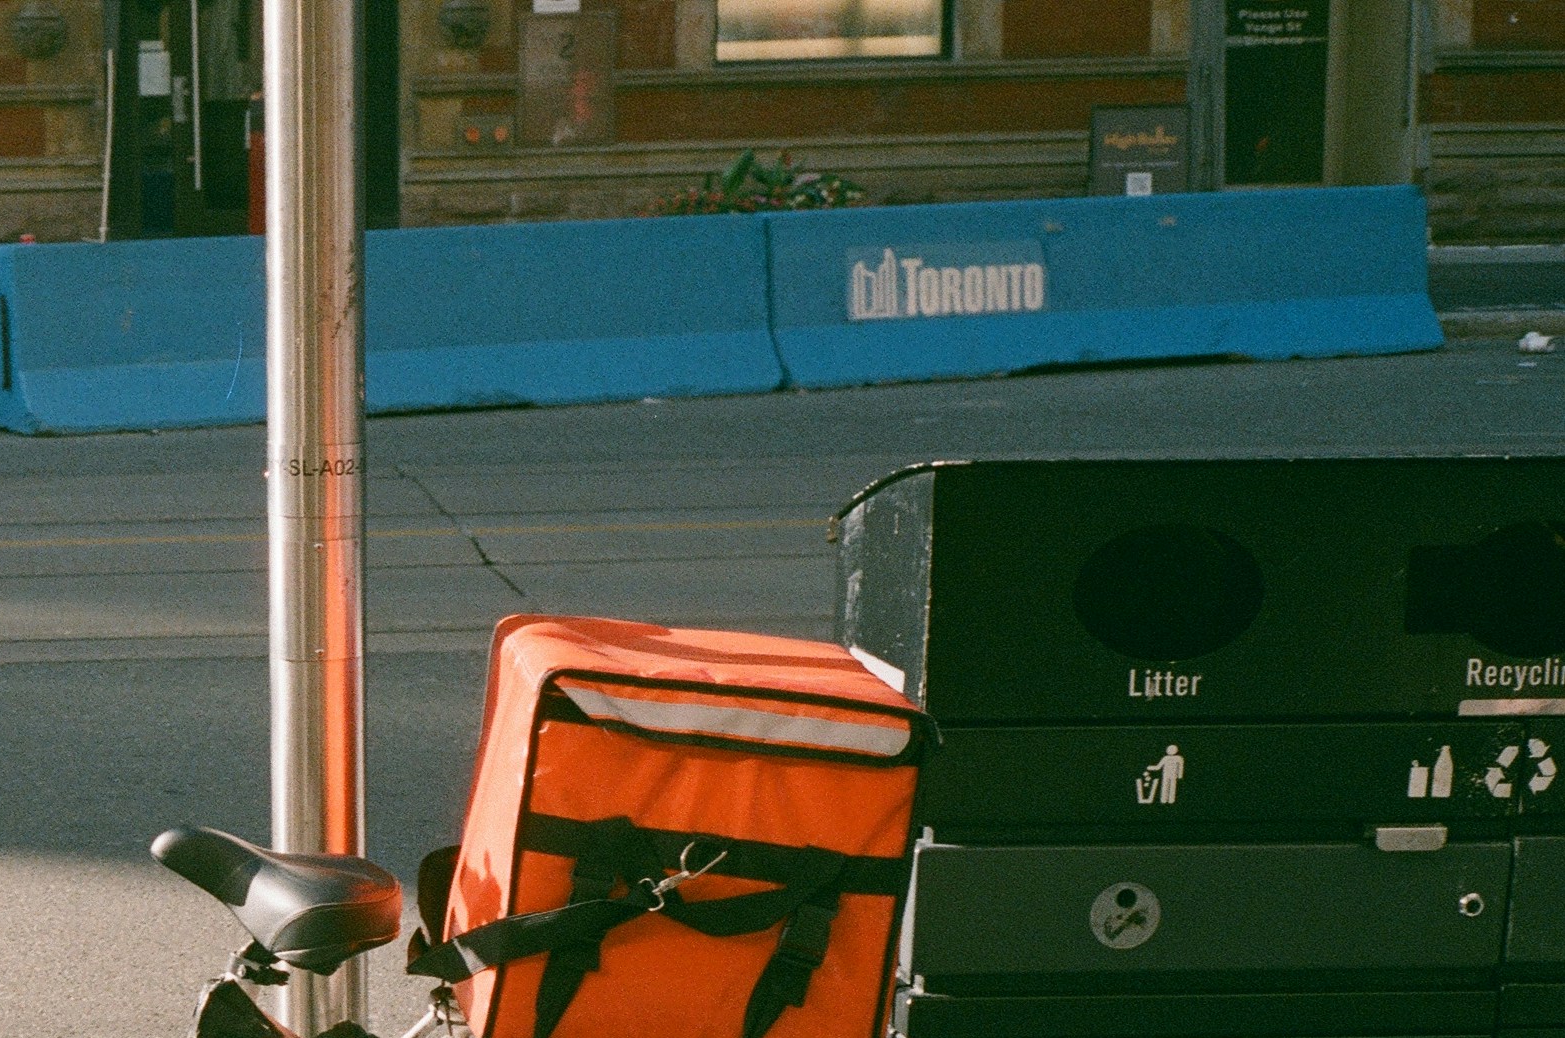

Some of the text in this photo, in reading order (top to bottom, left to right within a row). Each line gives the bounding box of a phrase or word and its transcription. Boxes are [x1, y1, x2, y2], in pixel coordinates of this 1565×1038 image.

[1244, 22, 1283, 34] Yonge
[901, 256, 1044, 317] TORONTO
[1129, 669, 1202, 697] Litter
